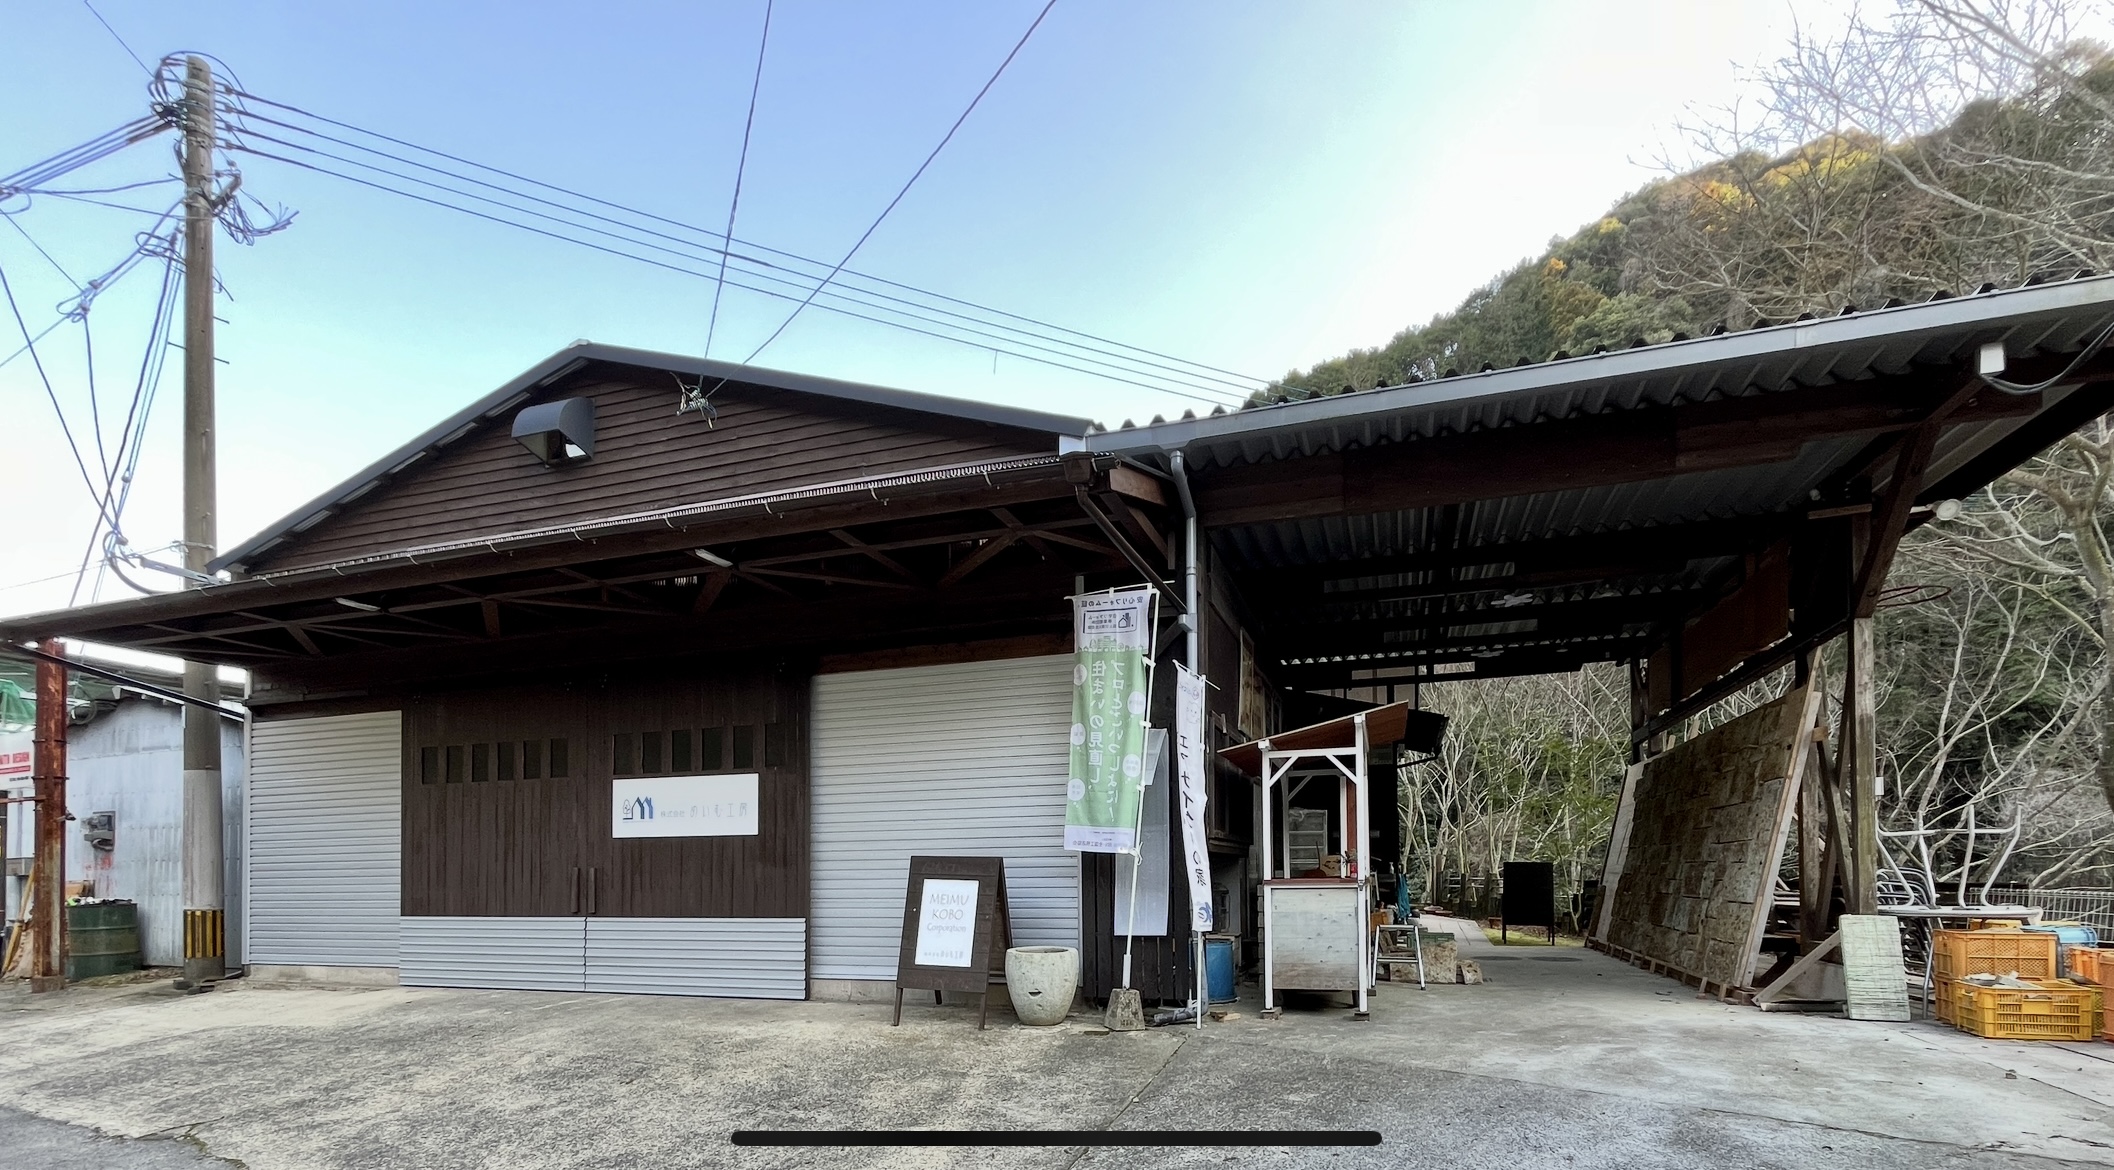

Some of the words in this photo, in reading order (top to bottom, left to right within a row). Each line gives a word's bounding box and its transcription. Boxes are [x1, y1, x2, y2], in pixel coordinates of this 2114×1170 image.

[929, 893, 969, 906] MEIMU
[932, 908, 964, 920] KOBO
[926, 922, 967, 934] Corporation
